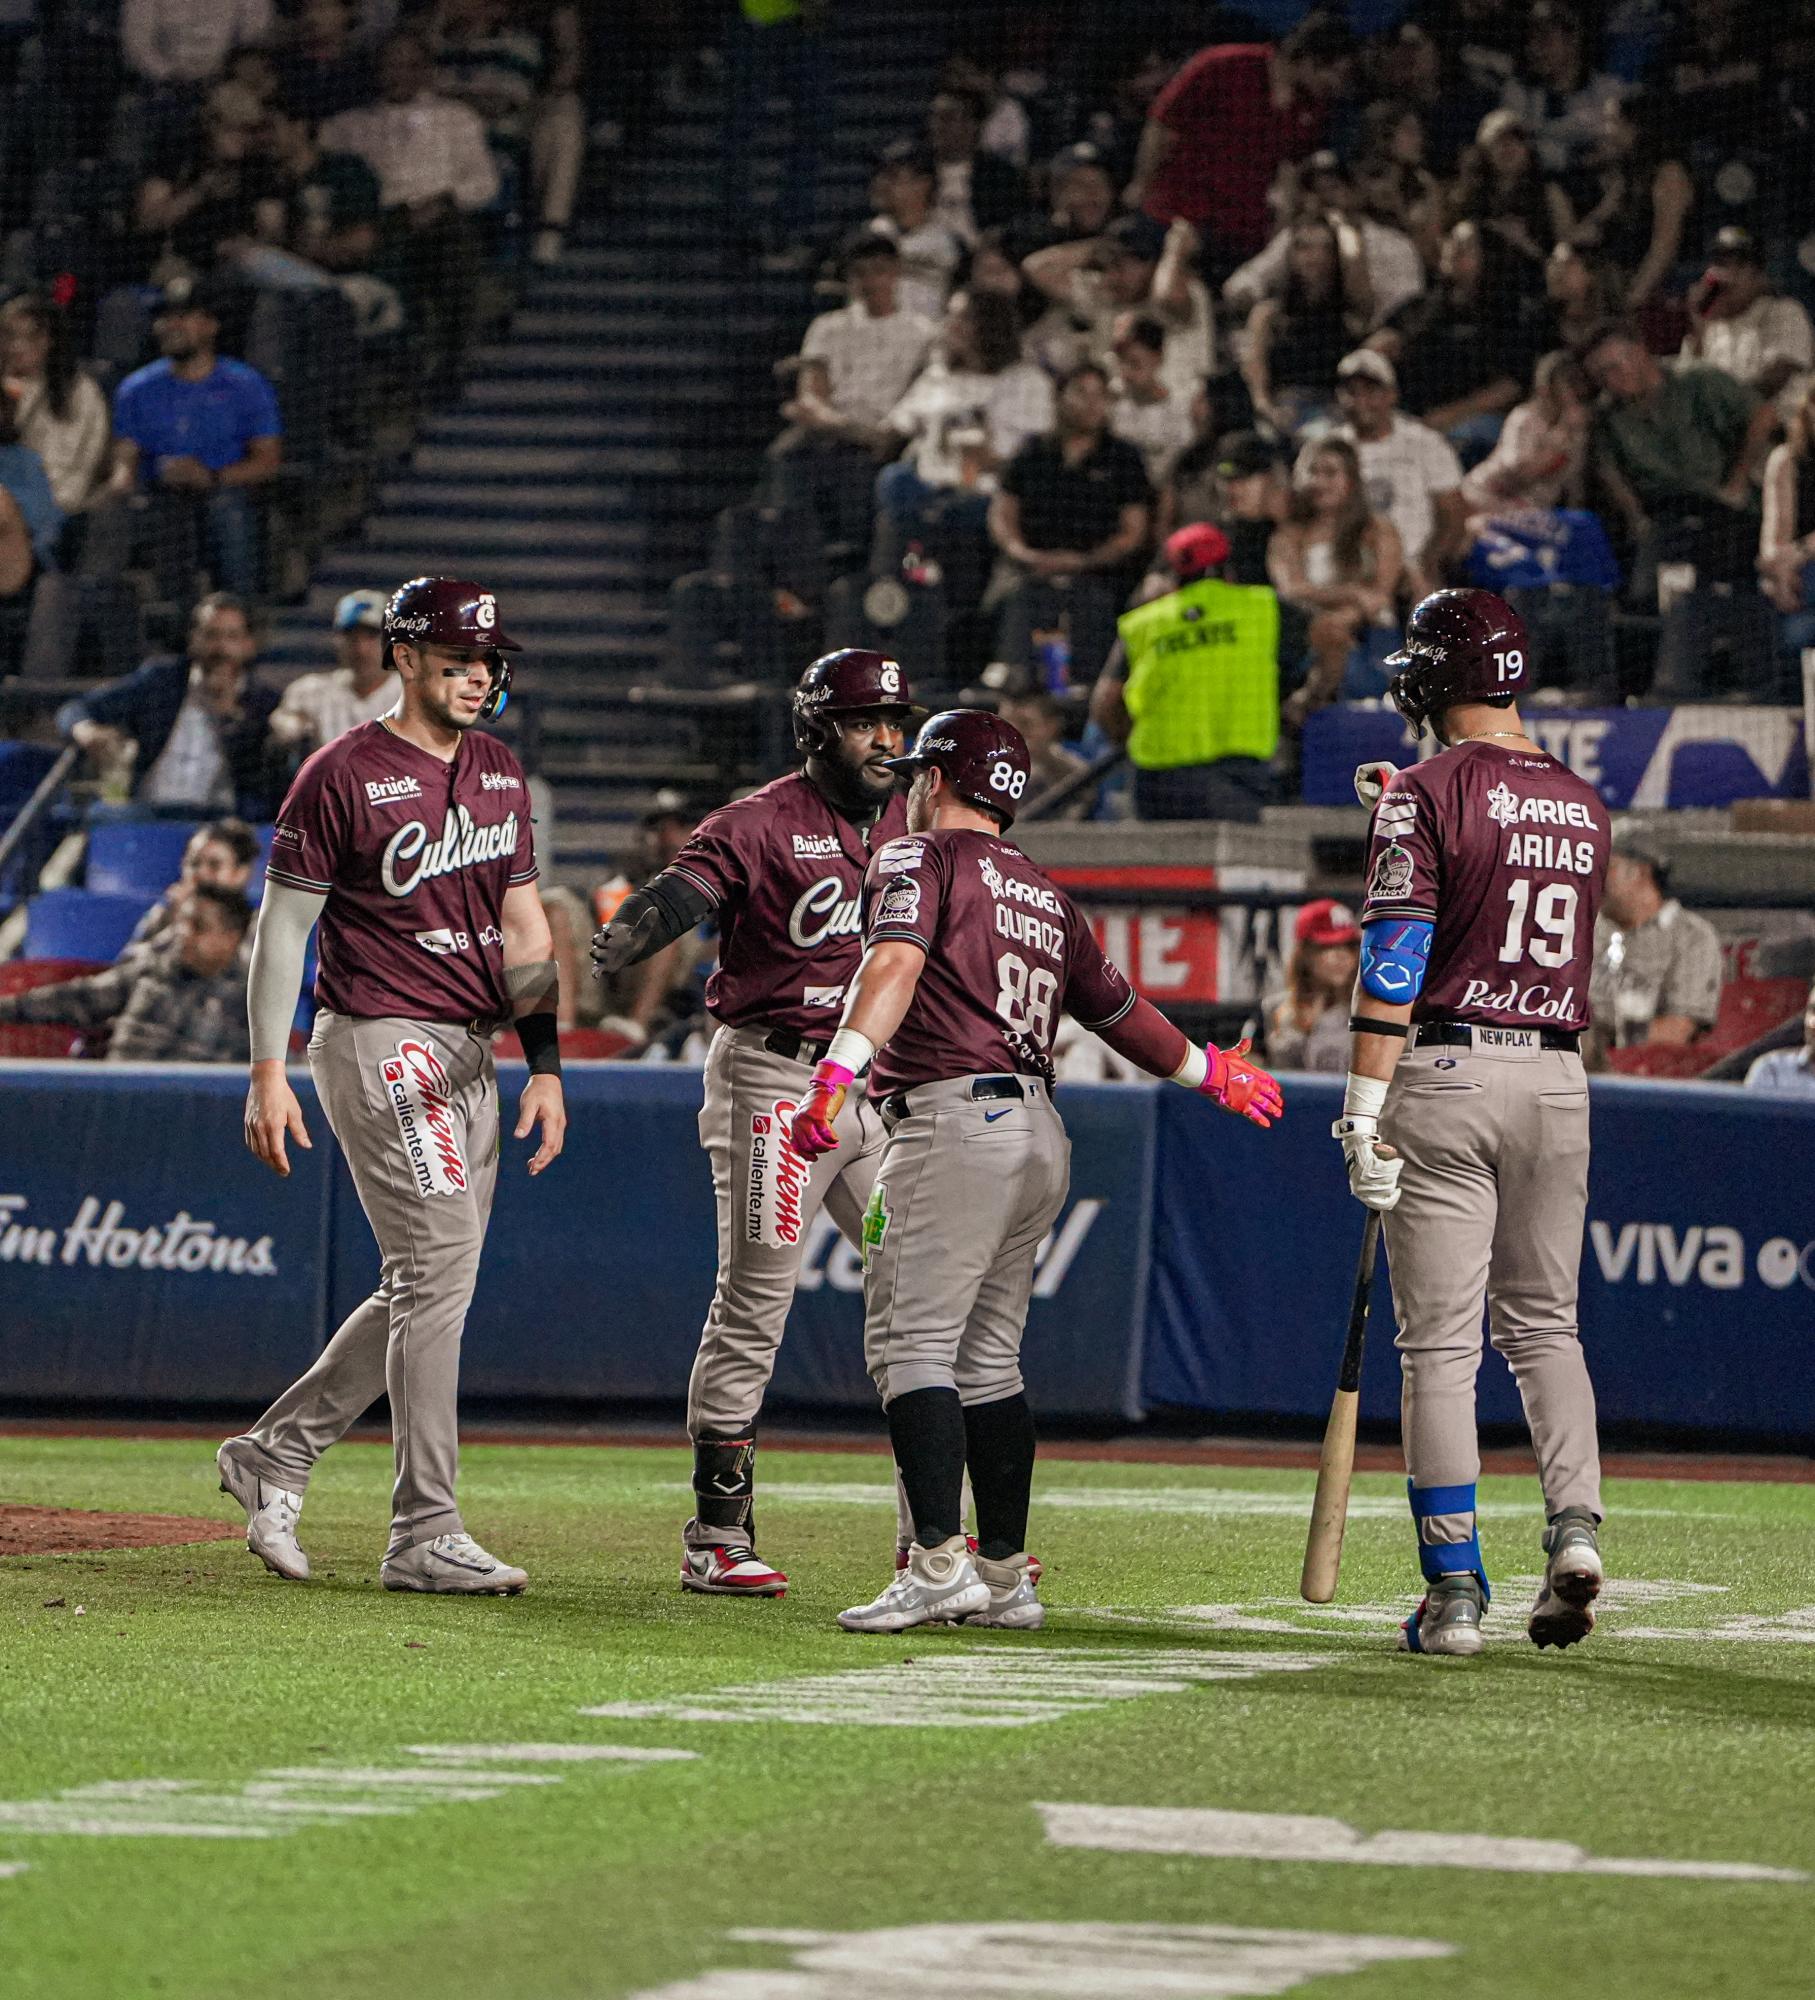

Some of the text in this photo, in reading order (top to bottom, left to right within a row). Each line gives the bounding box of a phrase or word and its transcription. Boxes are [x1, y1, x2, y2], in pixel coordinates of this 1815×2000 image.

[1493, 650, 1524, 682] 19
[364, 775, 421, 800] Brück
[989, 761, 1027, 800] 88
[1519, 798, 1599, 832] ARIEL
[1506, 833, 1594, 875] ARIAS
[1499, 879, 1579, 969] 19
[996, 952, 1058, 1049] 88
[1453, 979, 1519, 1012] Red
[1480, 1028, 1533, 1047] NEW PLAY.
[393, 1083, 435, 1194] caliente.mx
[747, 1136, 769, 1241] caliente.mx
[60, 1195, 277, 1275] Hortons
